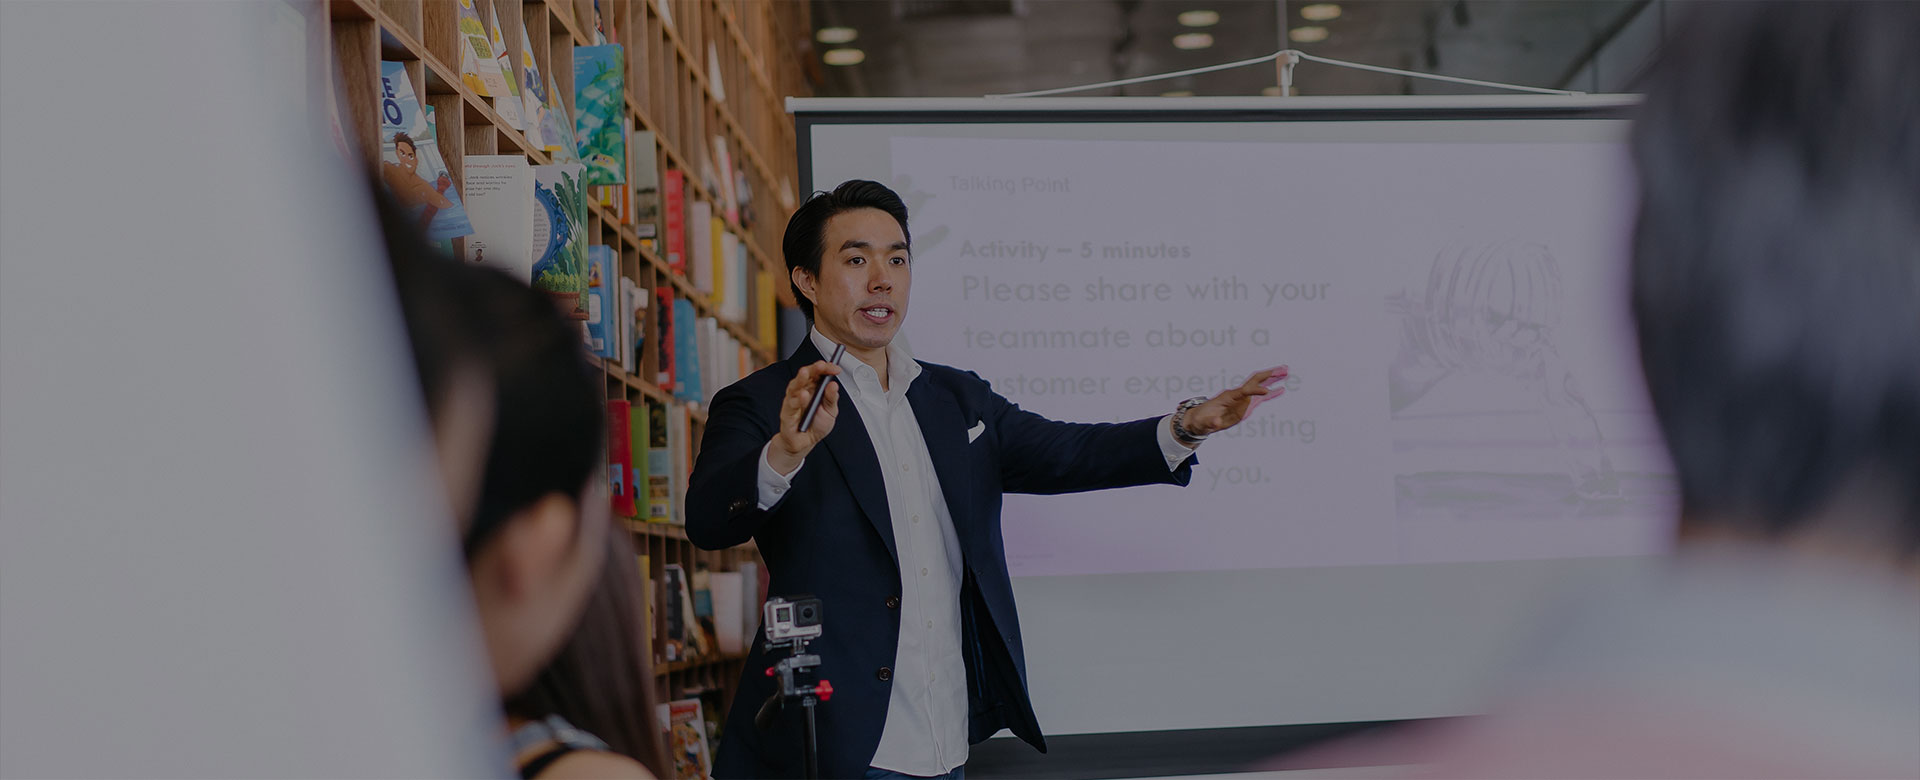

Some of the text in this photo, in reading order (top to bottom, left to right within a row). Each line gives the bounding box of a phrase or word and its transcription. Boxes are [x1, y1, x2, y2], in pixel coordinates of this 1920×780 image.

[948, 175, 1071, 197] Talking Point
[959, 239, 1049, 263] Activity
[1080, 241, 1093, 259] 5
[1102, 241, 1192, 260] minutes
[962, 274, 1331, 309] Please share with your
[962, 321, 1270, 350] teammate about a
[994, 367, 1302, 400] stomer experiee
[1215, 413, 1316, 444] asting
[1208, 465, 1272, 491] you.
